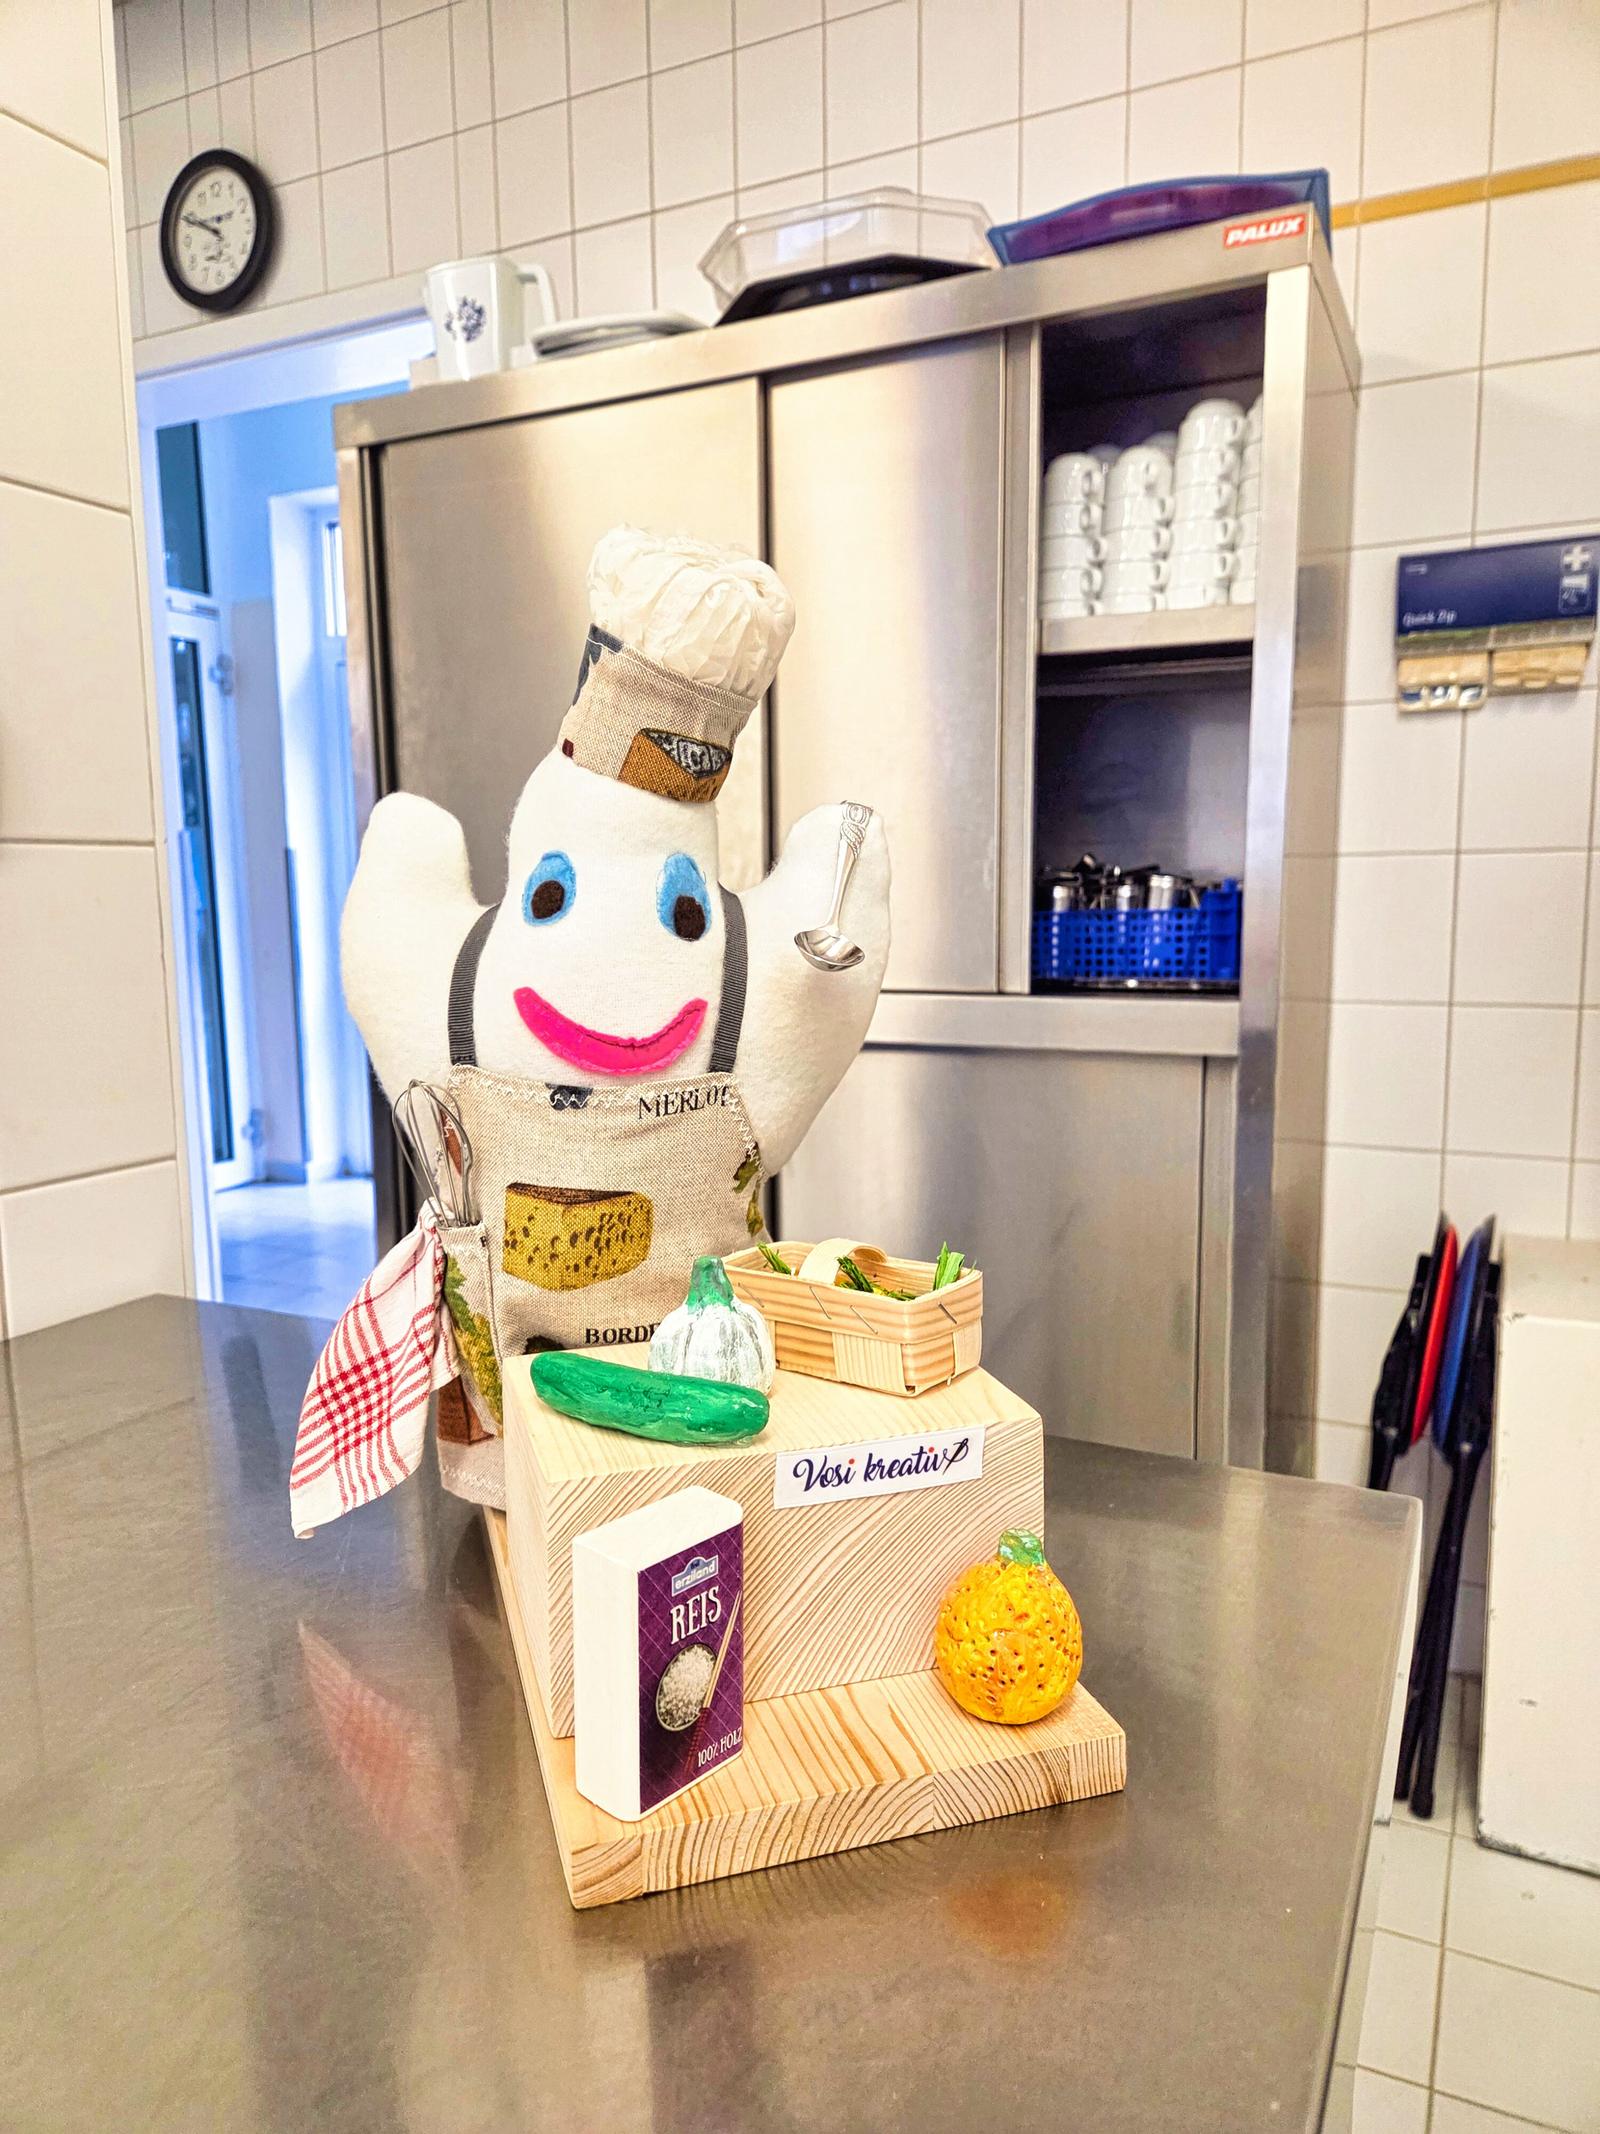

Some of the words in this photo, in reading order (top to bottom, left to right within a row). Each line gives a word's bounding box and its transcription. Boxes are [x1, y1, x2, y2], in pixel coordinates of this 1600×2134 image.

[210, 181, 222, 198] 12
[237, 198, 248, 214] 2
[1225, 216, 1304, 246] PALUX
[793, 1455, 856, 1492] Vosi
[863, 1443, 949, 1483] kreativ
[670, 1585, 722, 1645] REIS
[698, 1742, 719, 1768] 100%
[720, 1726, 743, 1754] HOLZ
